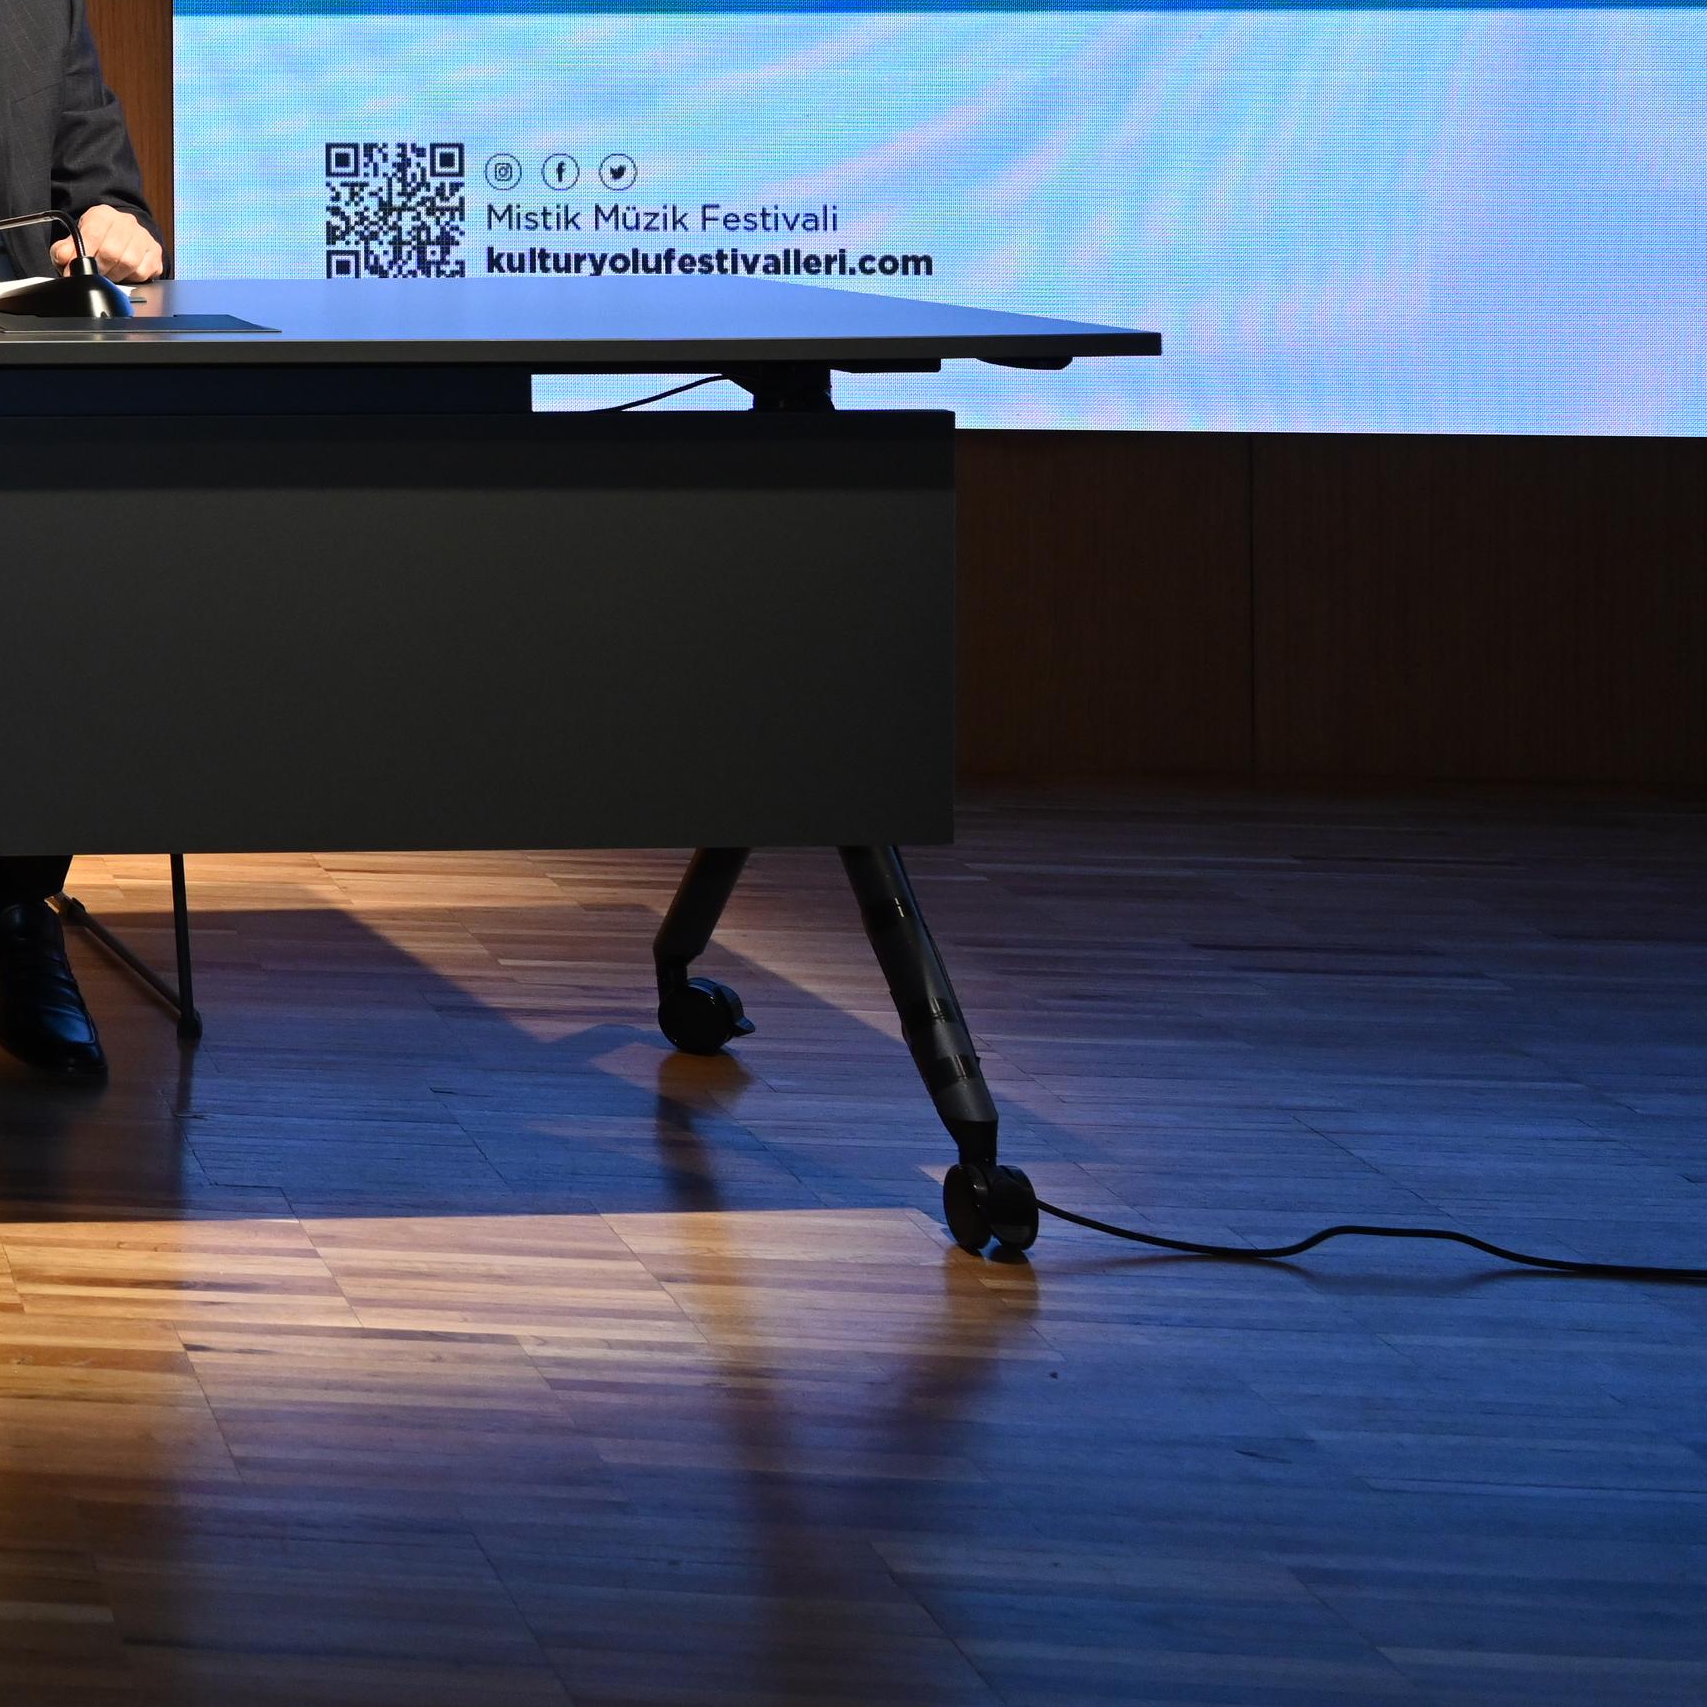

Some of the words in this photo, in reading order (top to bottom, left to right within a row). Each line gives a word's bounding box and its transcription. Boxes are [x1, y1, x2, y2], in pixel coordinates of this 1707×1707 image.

[486, 203, 582, 231] Mistik
[594, 203, 689, 231] Müzik
[700, 203, 838, 232] Festivali
[486, 246, 934, 276] kulturyolufestivalleri.com
